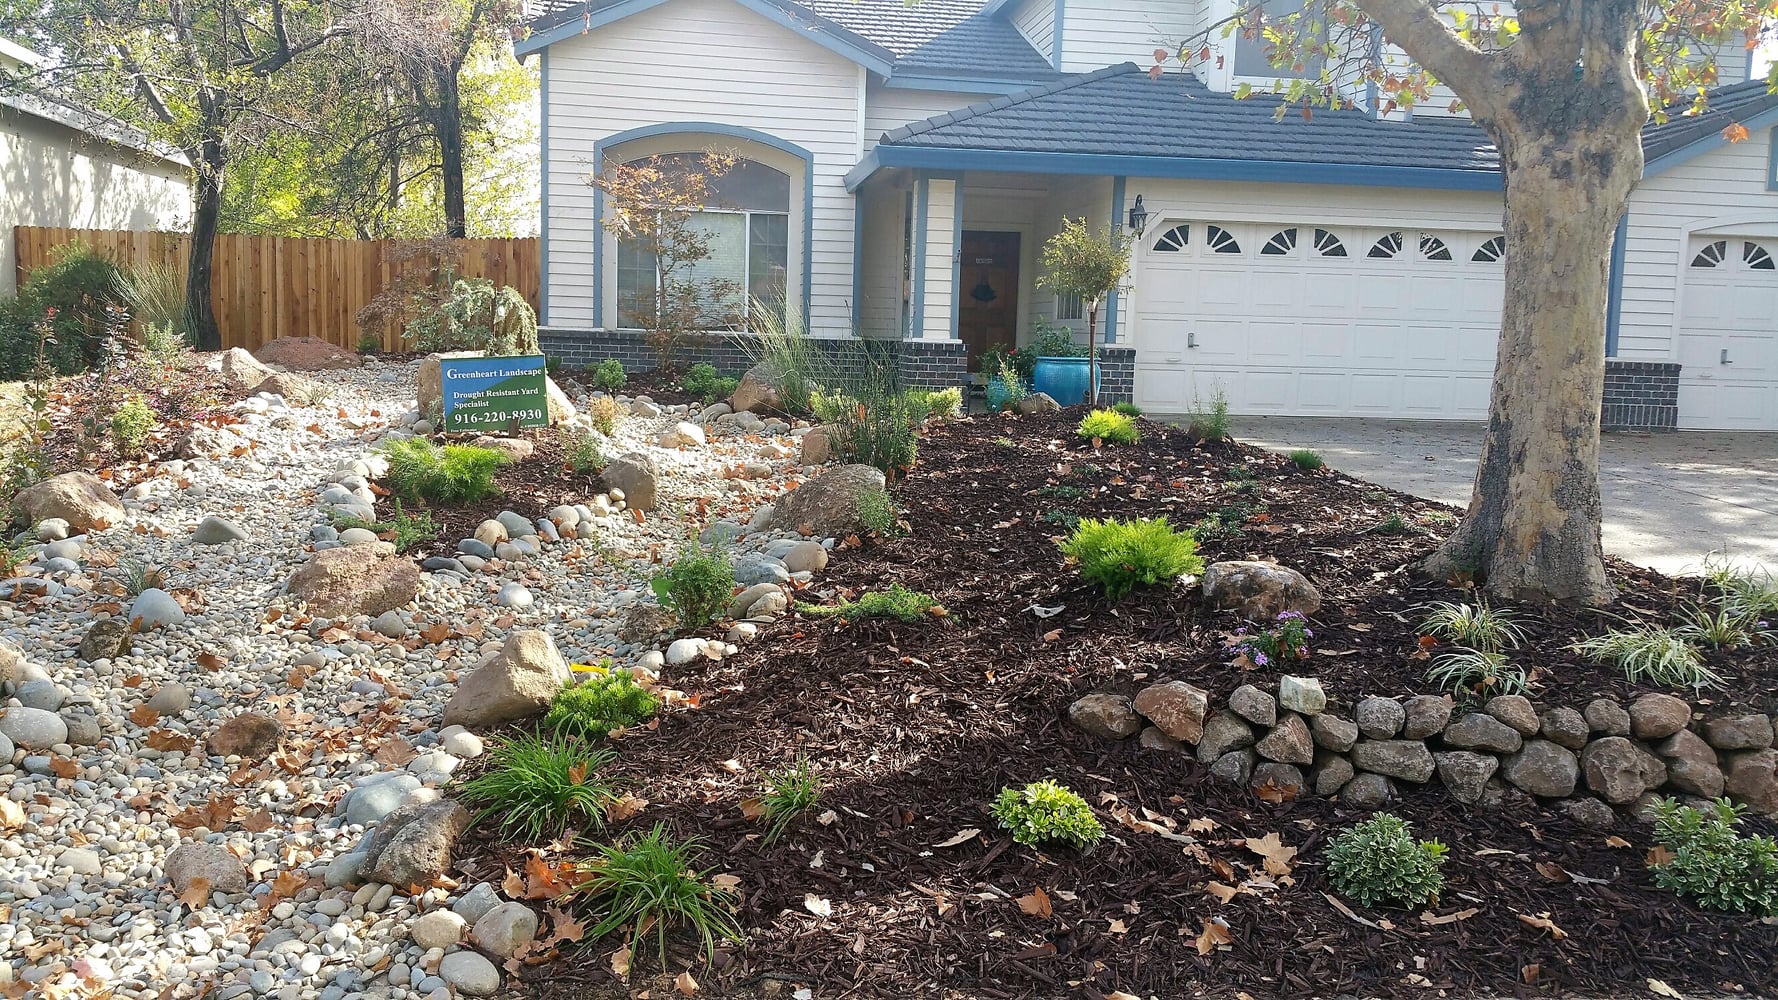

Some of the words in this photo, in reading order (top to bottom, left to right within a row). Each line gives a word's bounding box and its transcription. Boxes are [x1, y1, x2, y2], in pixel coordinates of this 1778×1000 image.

[447, 368, 497, 380] Greenheart
[500, 368, 542, 377] Landscape
[454, 390, 484, 399] Drought
[454, 400, 489, 410] Specialist
[455, 409, 542, 424] 916-220-8930
